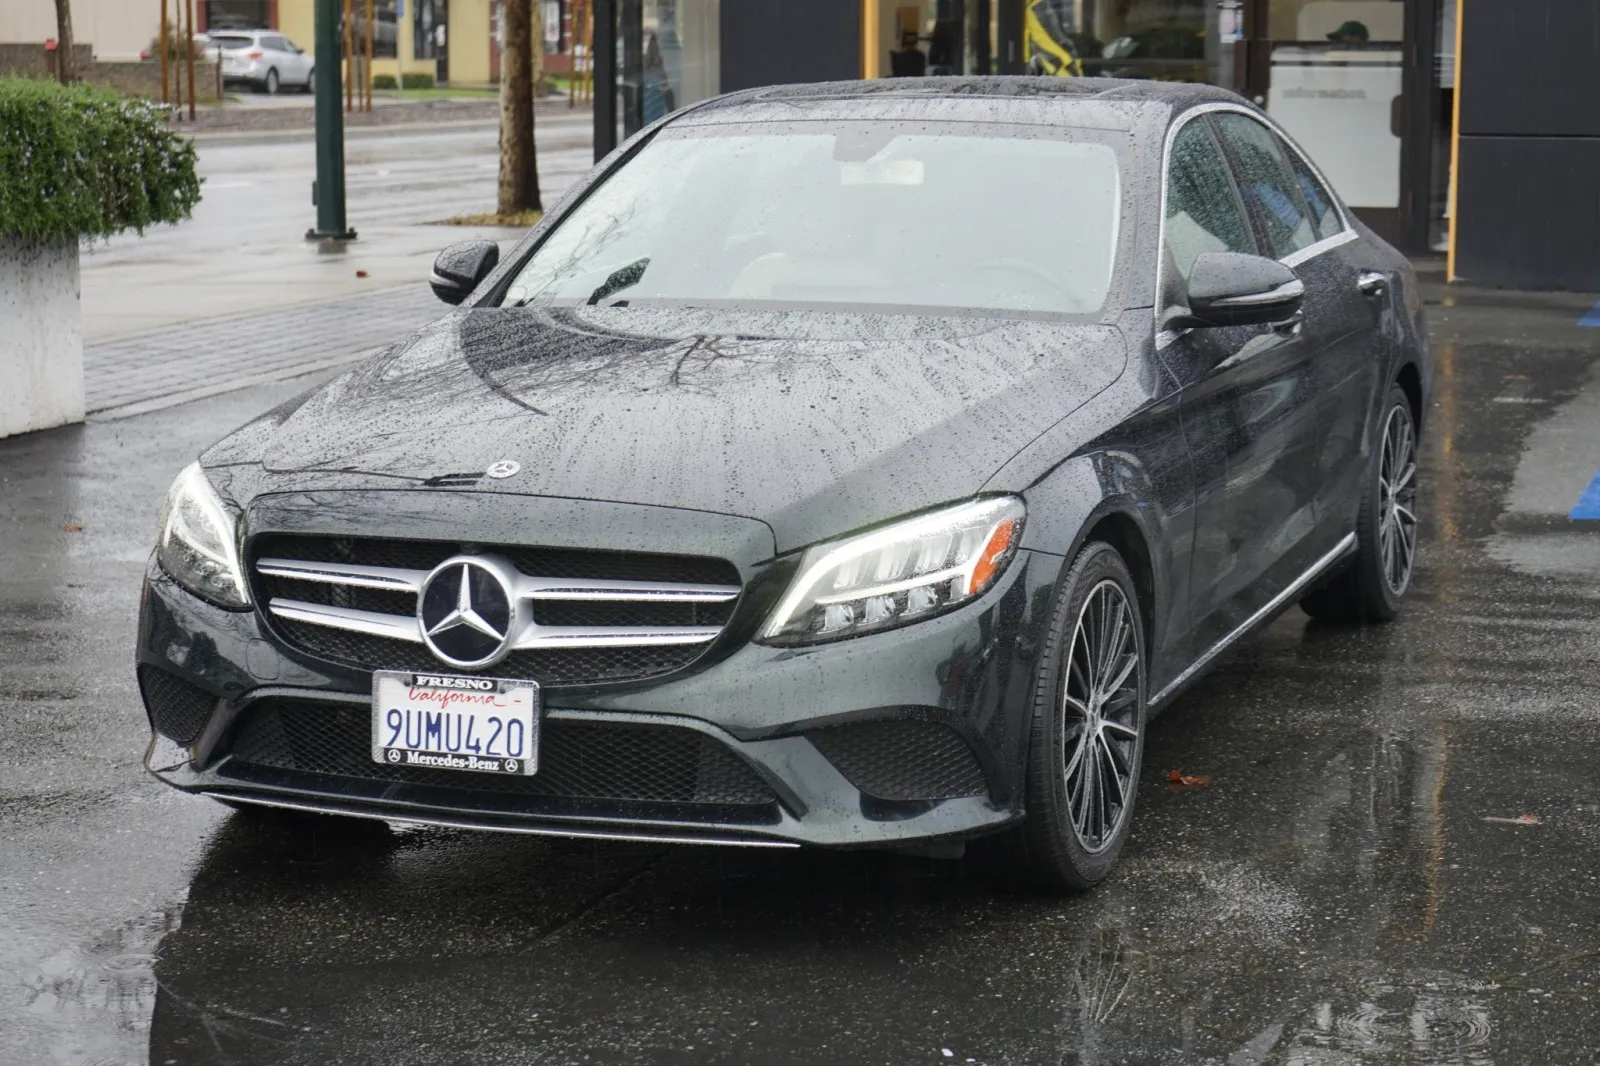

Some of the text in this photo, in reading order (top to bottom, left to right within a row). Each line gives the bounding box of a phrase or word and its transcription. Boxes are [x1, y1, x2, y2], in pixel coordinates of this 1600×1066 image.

[416, 675, 493, 691] FRESNO
[408, 687, 506, 709] California
[386, 708, 524, 758] 9UMU420
[406, 750, 500, 771] Mercedes-Benz
